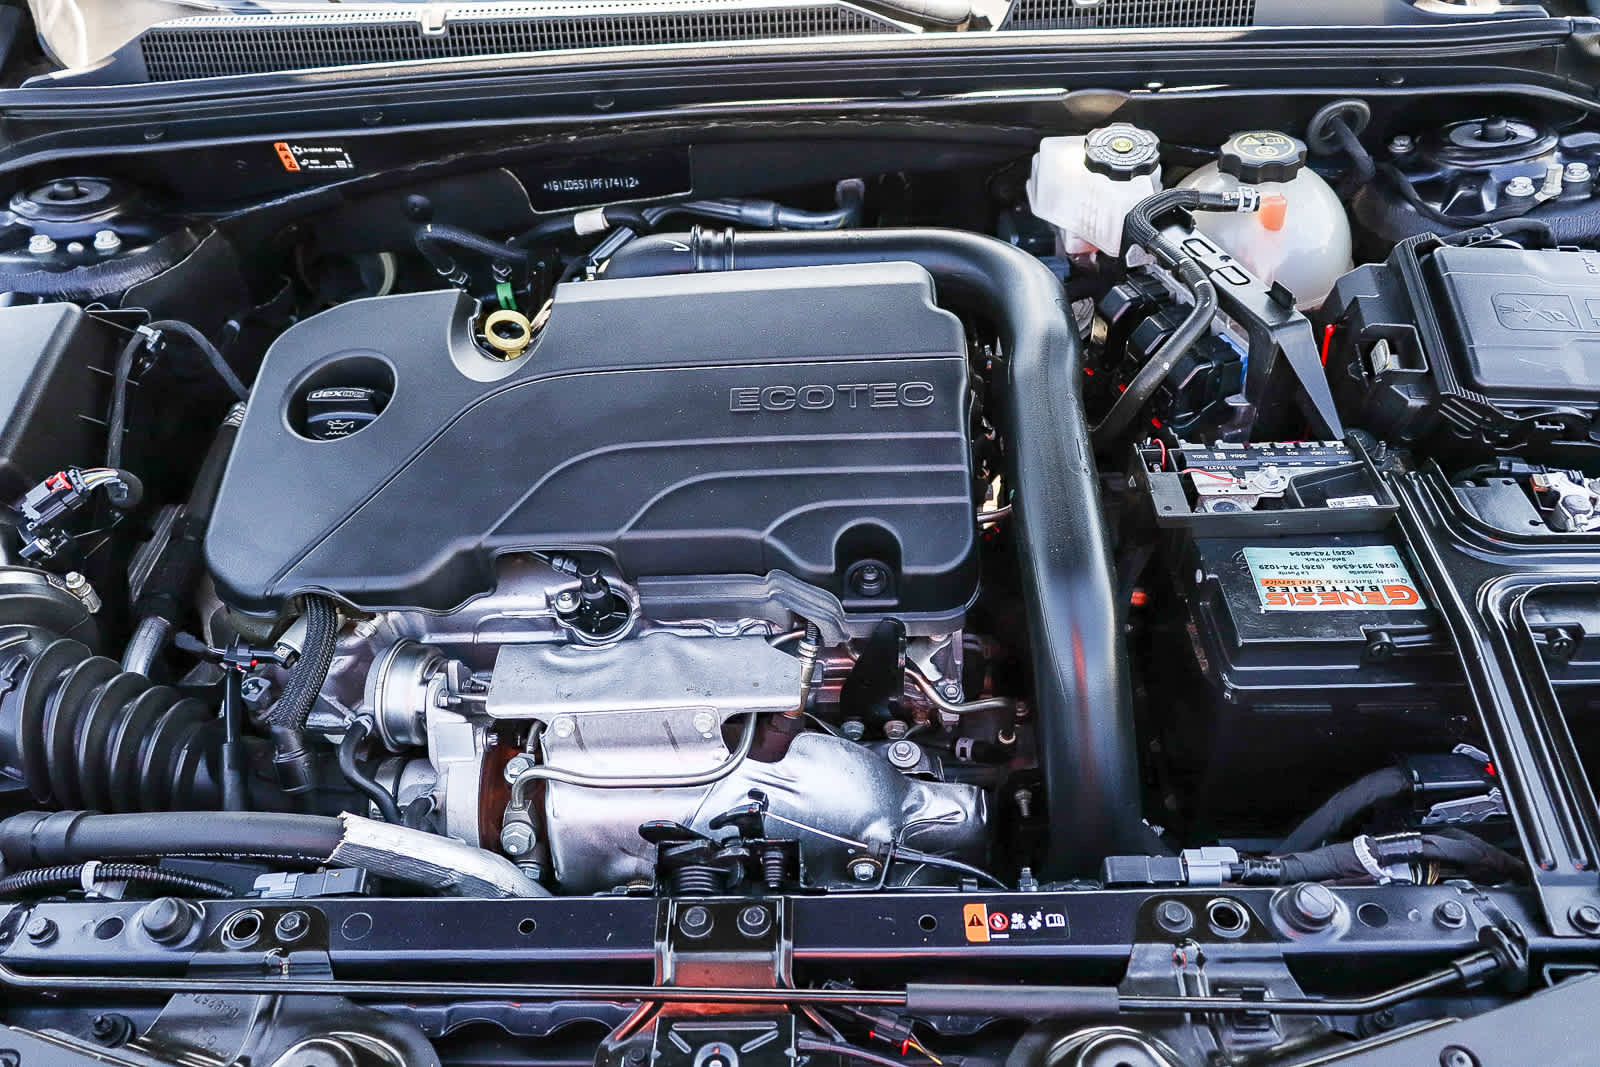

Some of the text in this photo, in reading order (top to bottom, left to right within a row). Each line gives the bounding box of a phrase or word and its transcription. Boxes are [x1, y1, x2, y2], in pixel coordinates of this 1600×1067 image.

[728, 381, 936, 412] ECOTEC
[1375, 577, 1408, 585] Quality
[1265, 585, 1419, 606] GENESIS
[1266, 585, 1380, 593] BATTERIES
